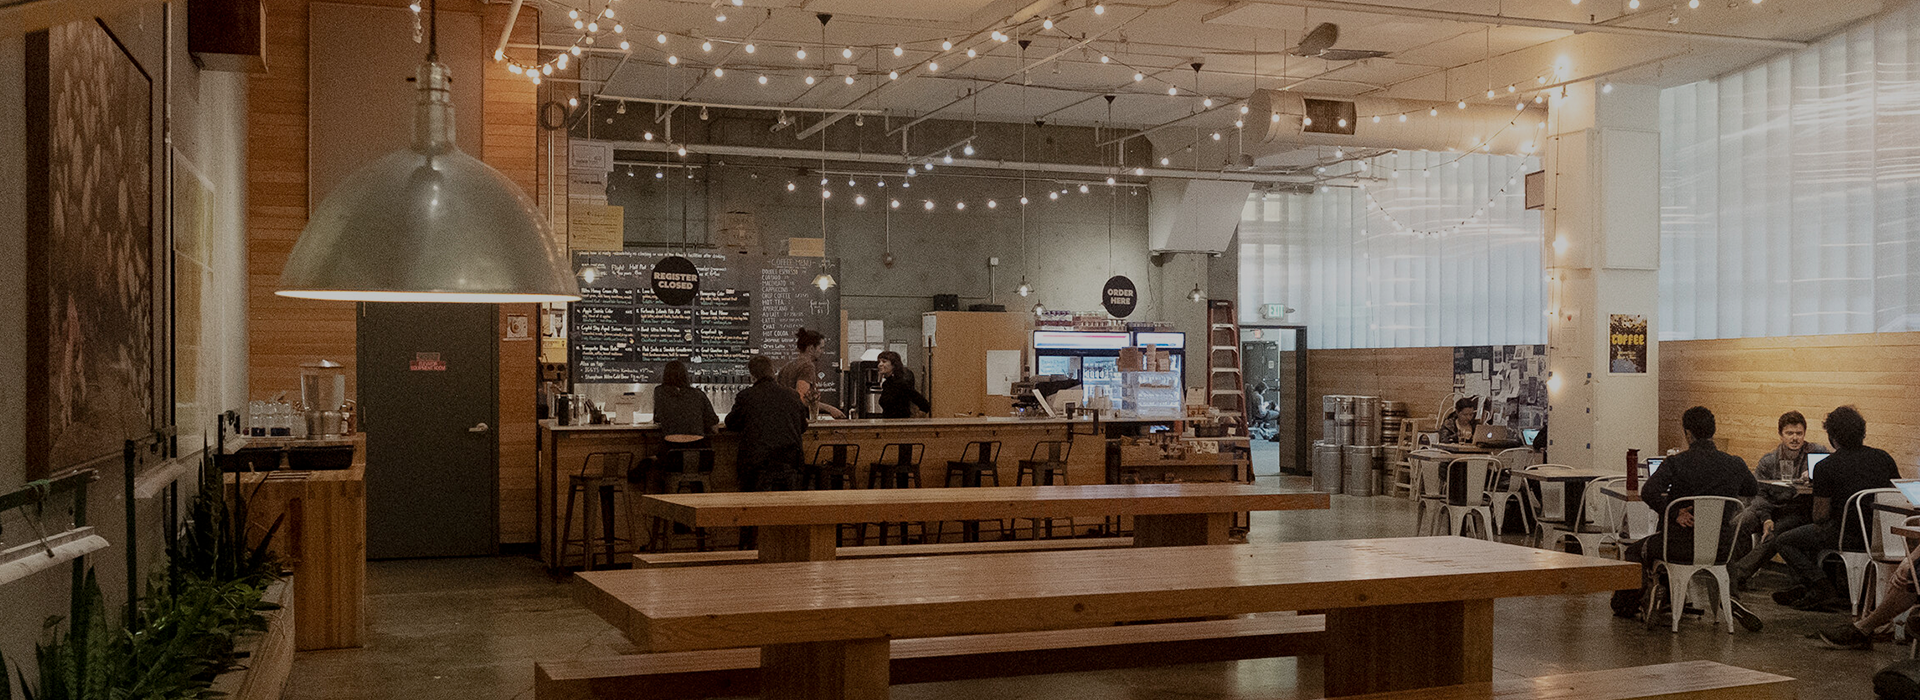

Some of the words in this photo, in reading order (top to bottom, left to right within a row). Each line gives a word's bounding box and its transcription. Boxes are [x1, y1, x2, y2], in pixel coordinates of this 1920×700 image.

[771, 259, 792, 267] COFFEE
[795, 259, 812, 267] MENU
[653, 272, 698, 282] REGISTER
[658, 281, 694, 290] CLOSED
[1107, 288, 1134, 297] ORDER
[1110, 297, 1131, 305] HERE
[1611, 333, 1645, 345] COFFEE
